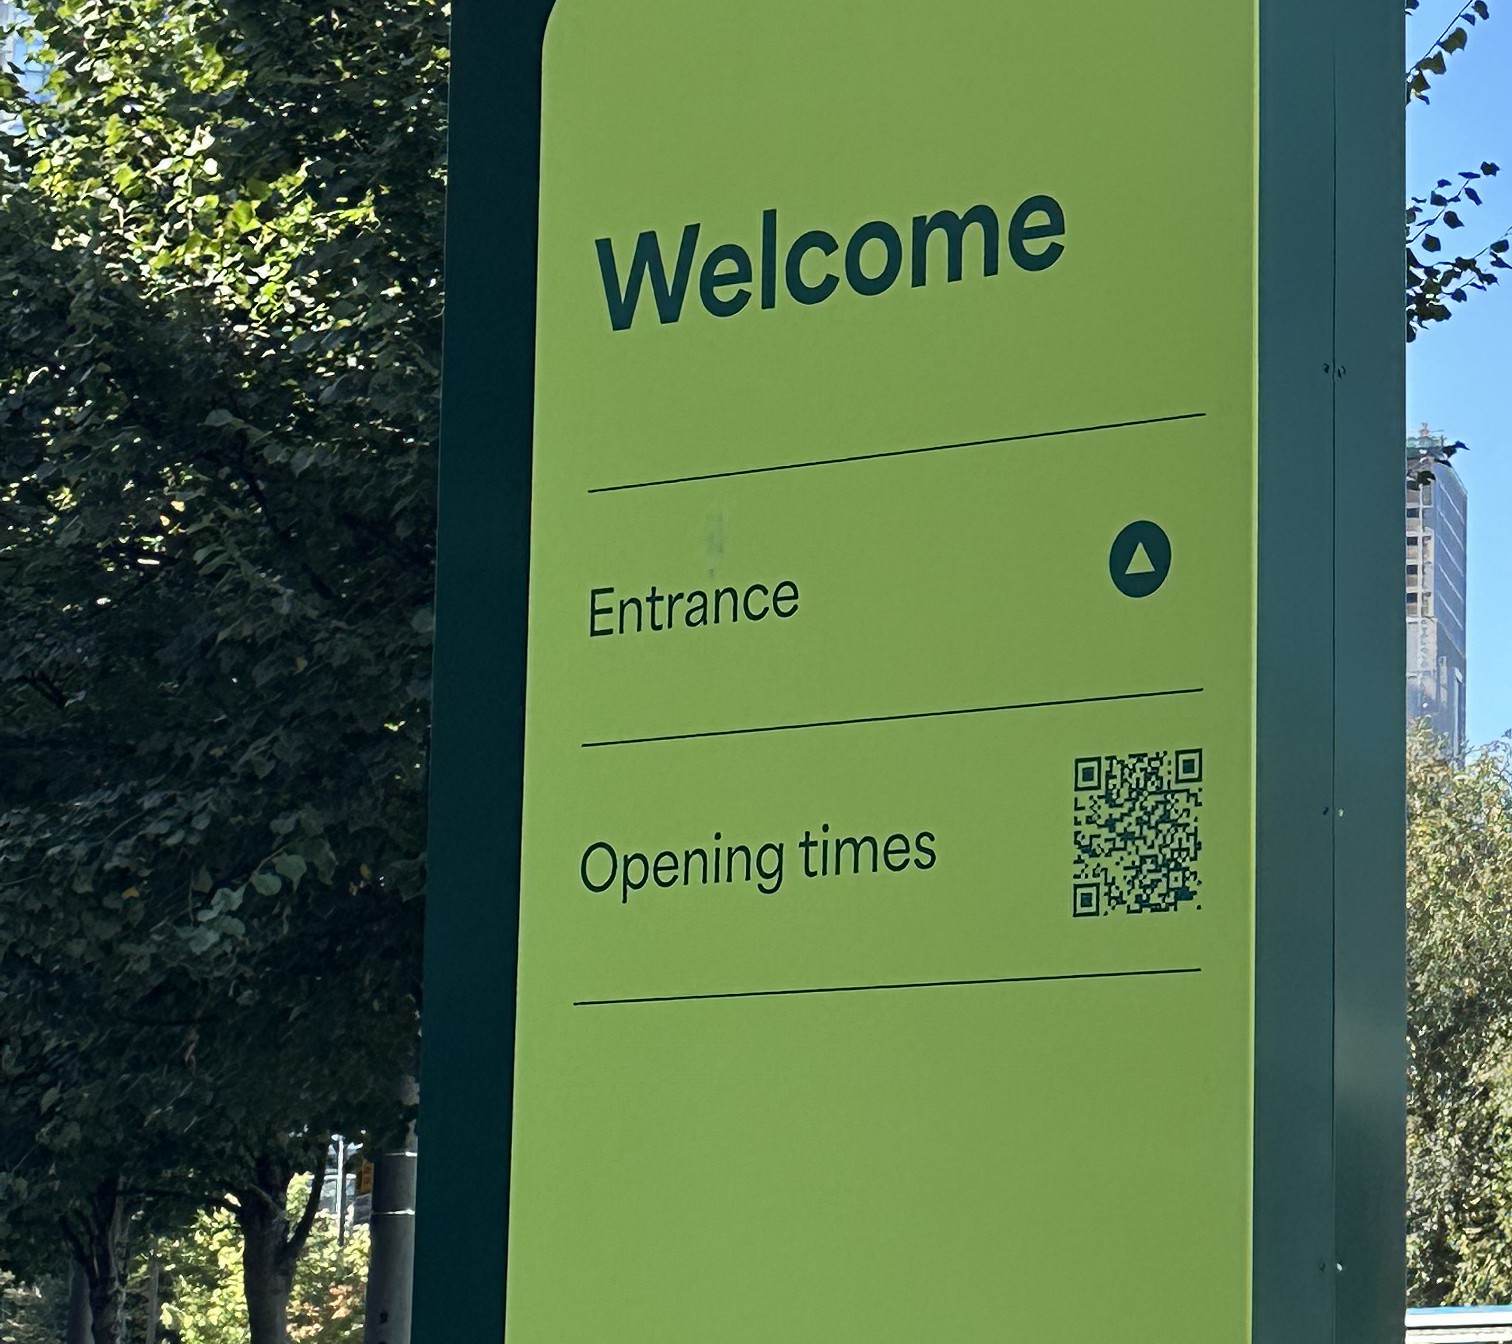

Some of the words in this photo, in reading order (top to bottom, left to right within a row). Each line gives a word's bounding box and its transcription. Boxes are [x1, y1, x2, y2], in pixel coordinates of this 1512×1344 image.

[594, 194, 1066, 332] Welcome
[589, 580, 799, 638] Entrance
[580, 830, 784, 904] Opening
[798, 823, 937, 878] times
